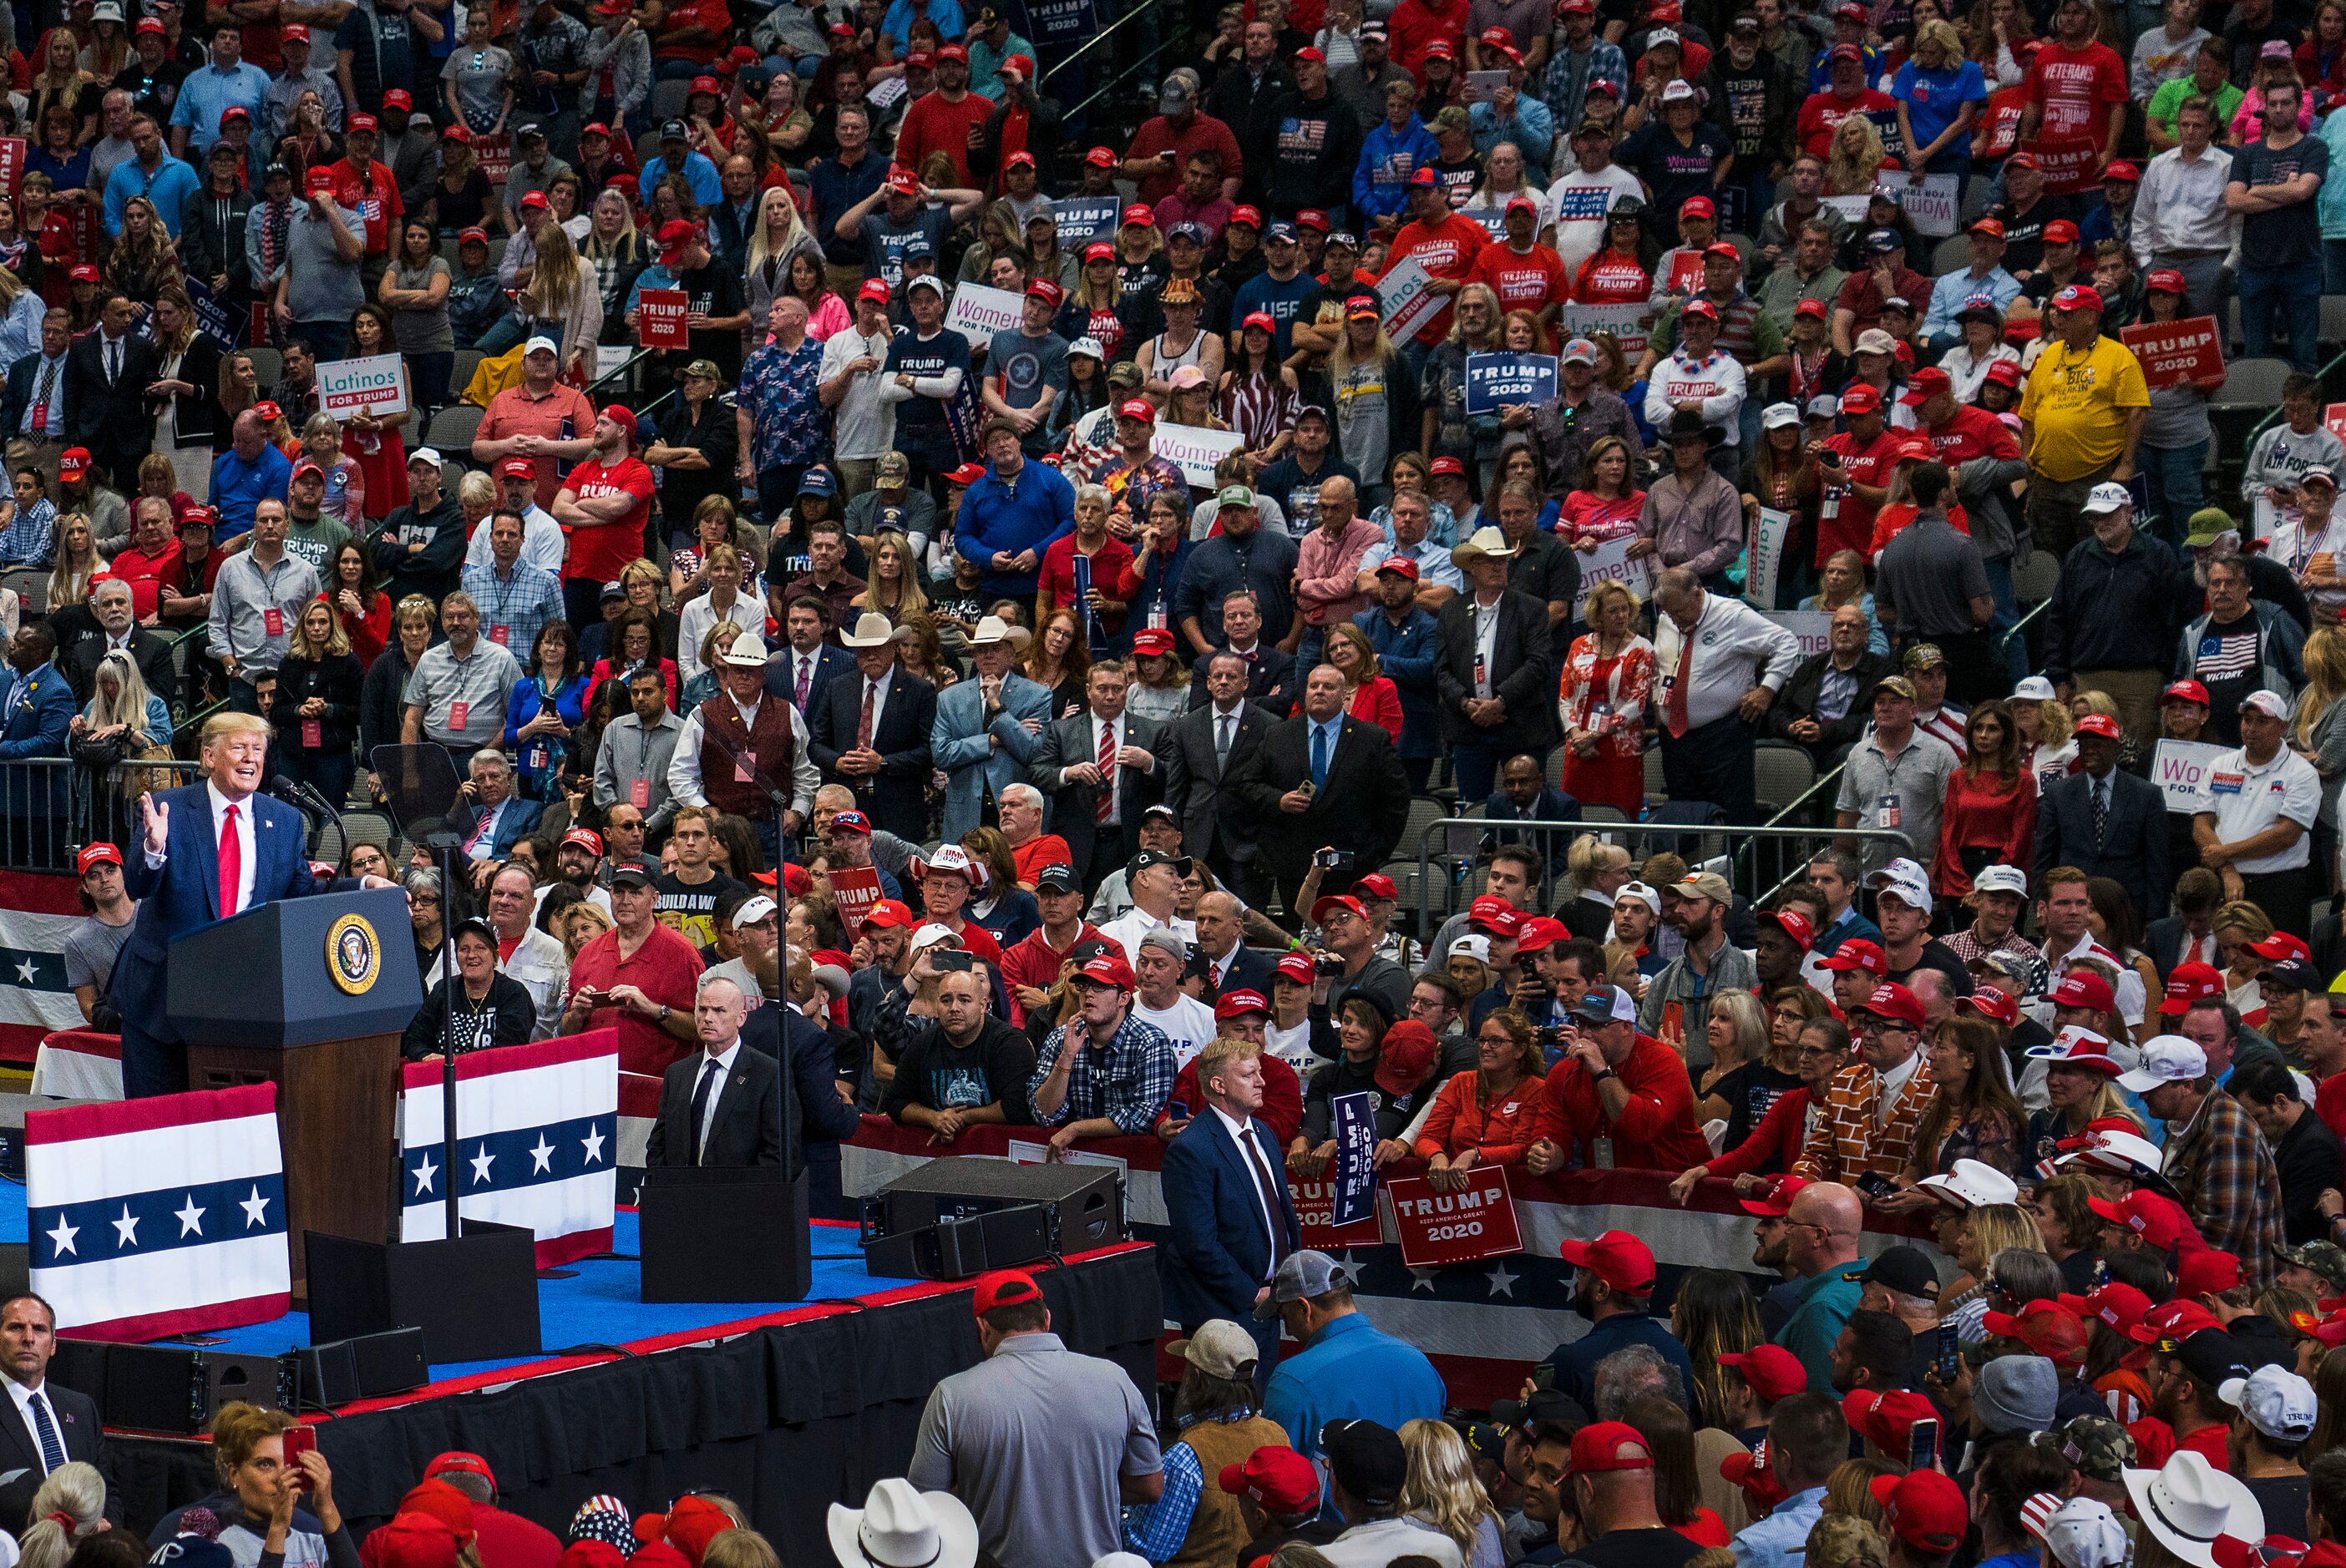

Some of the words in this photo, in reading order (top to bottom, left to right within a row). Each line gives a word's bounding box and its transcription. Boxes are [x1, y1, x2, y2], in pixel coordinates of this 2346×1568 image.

[1030, 0, 1090, 18] TRUMP
[1046, 18, 1079, 32] 2020
[2045, 63, 2094, 81] VETERANS
[2060, 109, 2090, 125] TRUMP
[1055, 209, 1113, 223] RUMP
[879, 230, 924, 245] TRUMP
[1416, 255, 1453, 267] TRUMP
[1507, 287, 1542, 297] TRUMP
[1597, 280, 1637, 289] TRUMP
[641, 304, 686, 317] TRUMP
[651, 323, 676, 335] 2020
[958, 320, 979, 332] FOR
[2129, 331, 2212, 357] TRUMP
[900, 358, 945, 370] TRUMP
[2154, 357, 2197, 373] 2020
[1471, 366, 1552, 381] TRUMP
[325, 372, 396, 392] Latinos
[1489, 383, 1533, 397] 2020
[1669, 383, 1715, 397] TRUMP
[329, 396, 353, 407] FOR
[357, 390, 396, 404] TRUMP
[2286, 456, 2309, 473] FOR
[1756, 518, 1777, 596] Latinos
[2206, 669, 2243, 682] VICTORY.
[2169, 783, 2197, 794] FOR
[570, 831, 595, 843] TRUMP
[654, 895, 687, 910] BUILD
[687, 895, 697, 909] A
[834, 887, 879, 905] TRUMP
[331, 918, 352, 956] PRESIDENT
[364, 923, 378, 956] UNITED
[362, 963, 378, 989] STATES
[2137, 1052, 2151, 1071] SA
[1344, 1102, 1359, 1217] TRUMP
[1362, 1126, 1373, 1187] 2020
[1287, 1182, 1336, 1200] RUM
[1398, 1187, 1502, 1217] TRUMP
[1296, 1211, 1333, 1227] 202
[1420, 1217, 1434, 1226] KEEP
[1436, 1214, 1462, 1223] AMERICA
[1463, 1211, 1486, 1220] GREAT!
[1427, 1222, 1484, 1242] 2020
[2287, 1413, 2313, 1422] TRUMP
